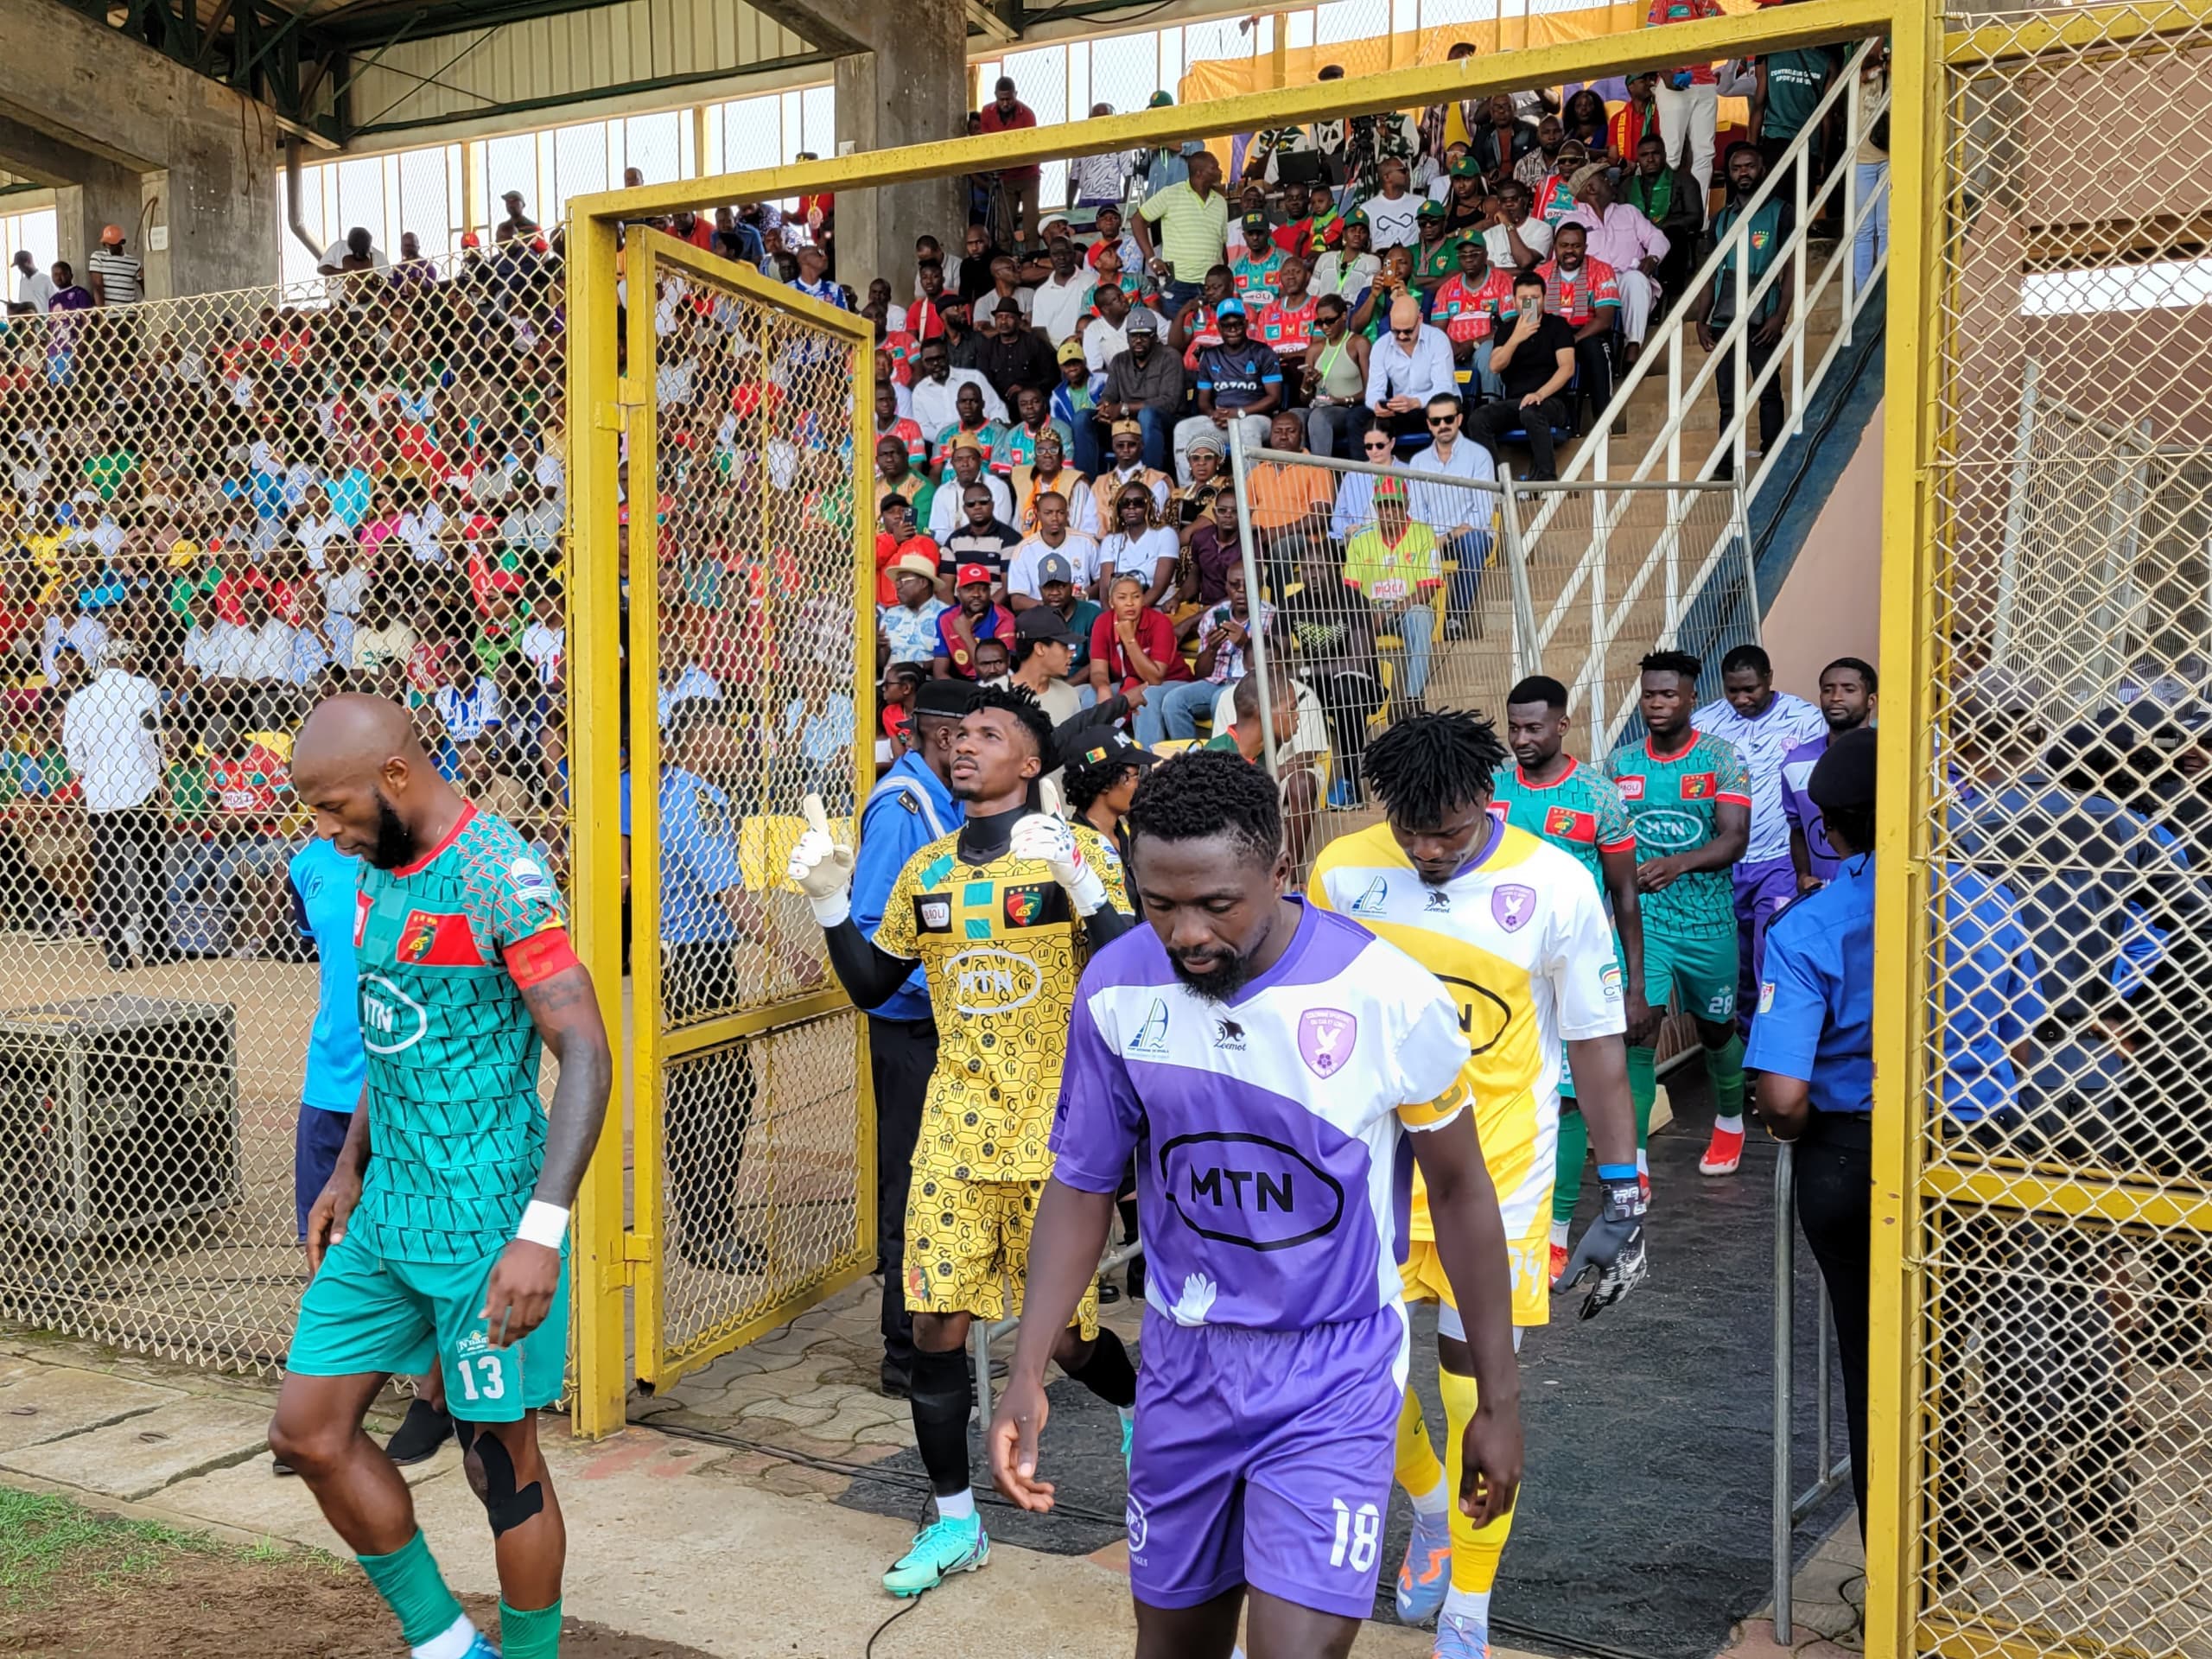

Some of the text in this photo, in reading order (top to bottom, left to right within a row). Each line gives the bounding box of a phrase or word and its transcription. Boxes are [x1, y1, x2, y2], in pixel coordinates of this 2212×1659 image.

[959, 969, 1014, 995] MTN
[1707, 995, 1733, 1015] 28
[1190, 1162, 1294, 1213] MTN
[458, 1356, 505, 1400] 13
[1330, 1497, 1380, 1573] 18
